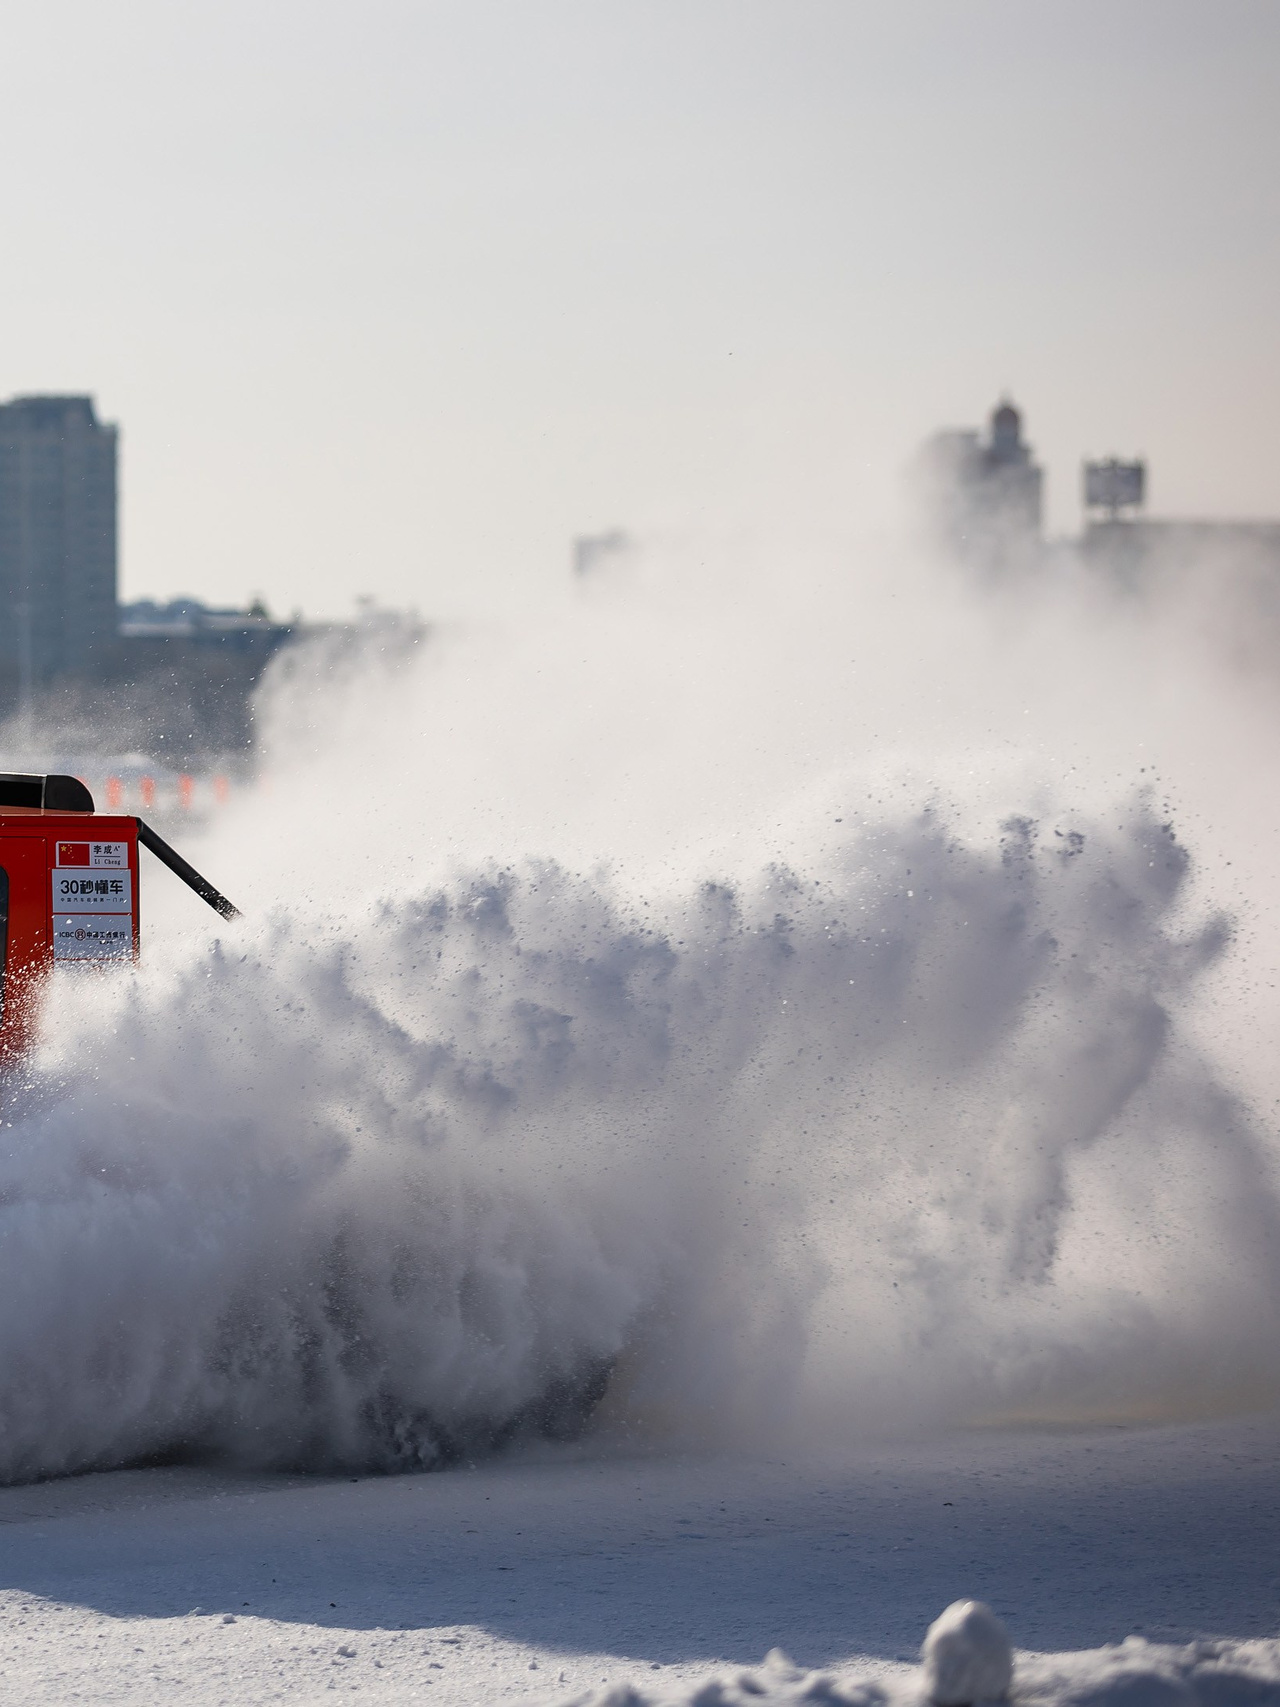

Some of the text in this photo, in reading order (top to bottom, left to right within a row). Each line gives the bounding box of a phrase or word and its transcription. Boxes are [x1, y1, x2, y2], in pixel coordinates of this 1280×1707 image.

[93, 845, 112, 855] 李成
[104, 858, 121, 866] Cheng
[60, 879, 124, 895] 30秒懂车
